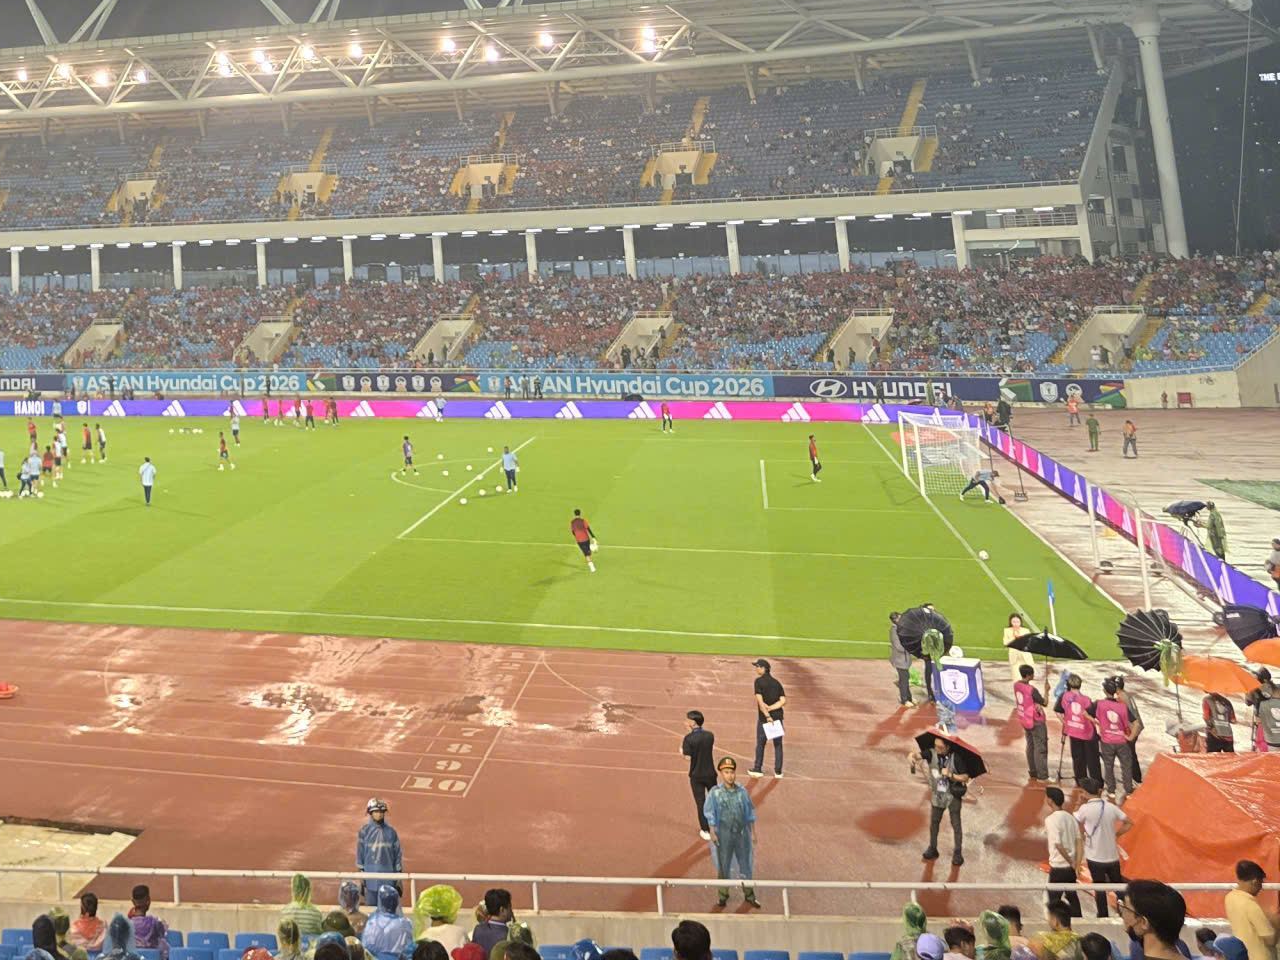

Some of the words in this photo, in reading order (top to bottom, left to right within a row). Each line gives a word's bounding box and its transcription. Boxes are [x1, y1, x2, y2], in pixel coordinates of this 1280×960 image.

[1258, 72, 1277, 82] THE
[146, 375, 218, 392] Hyundai
[220, 375, 257, 392] Cup
[258, 375, 300, 391] 2026
[576, 376, 662, 395] Hyundai
[665, 377, 709, 396] Cup
[712, 377, 765, 395] 2026
[14, 400, 45, 415] HANOI
[461, 727, 485, 737] 7
[446, 743, 473, 754] 8
[435, 760, 462, 771] 9
[407, 776, 467, 792] 10
